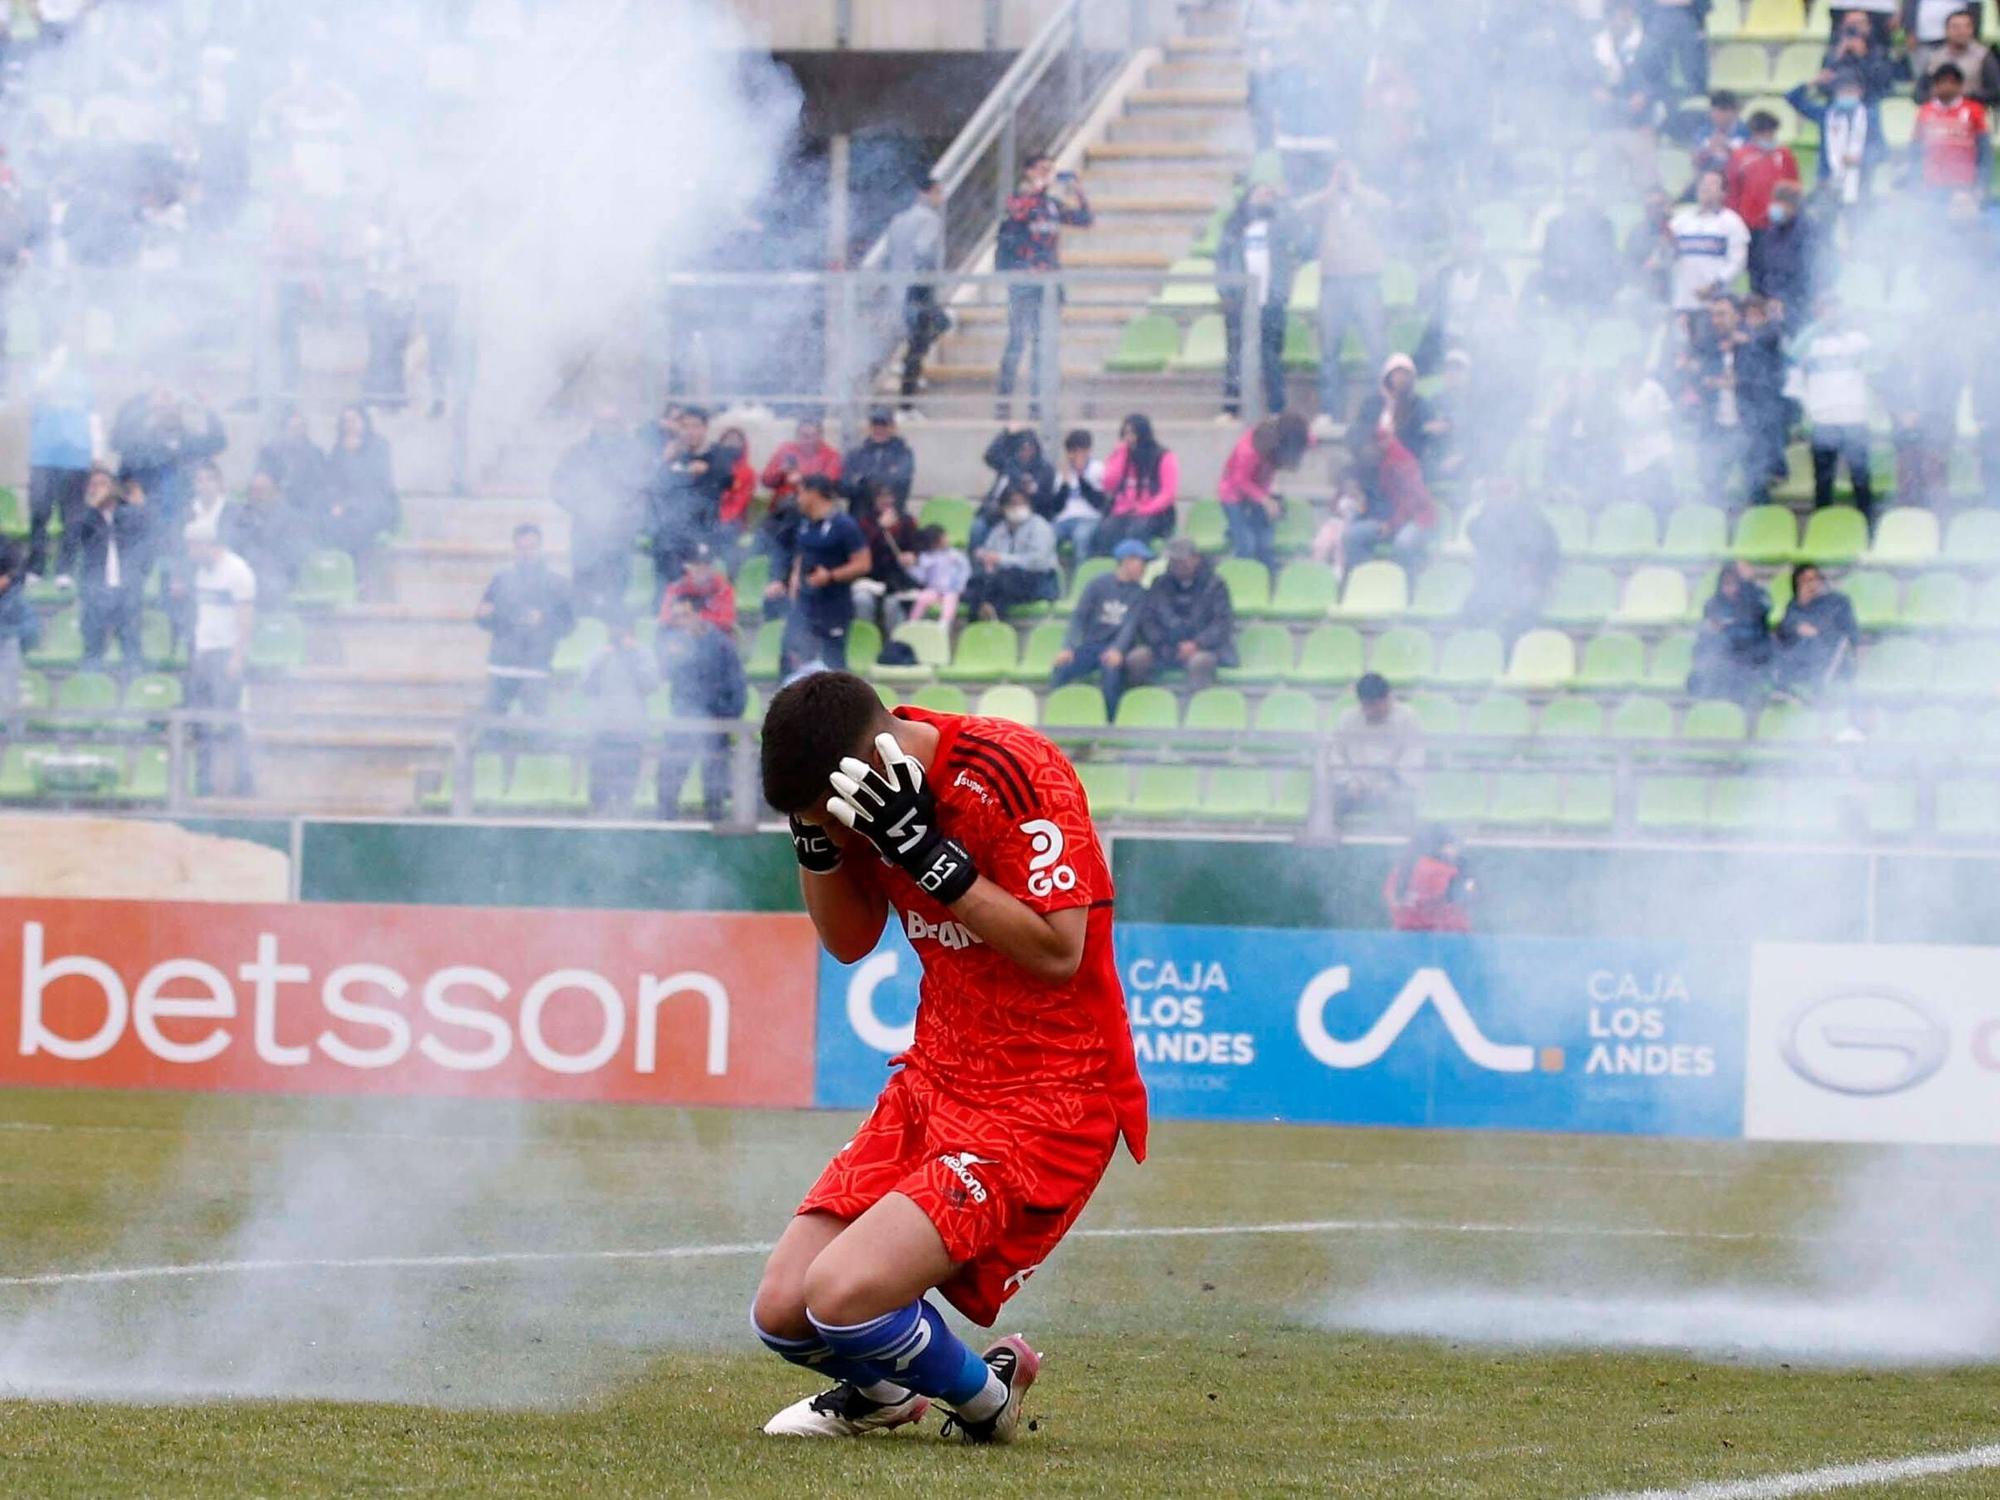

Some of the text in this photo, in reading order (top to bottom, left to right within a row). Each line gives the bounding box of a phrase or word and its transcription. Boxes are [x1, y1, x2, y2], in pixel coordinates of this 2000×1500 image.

[1028, 864, 1076, 897] GO
[1129, 959, 1229, 992] CAJA
[1587, 970, 1690, 1003] CAJA
[19, 921, 730, 1075] betsson
[1131, 995, 1204, 1028] LOS
[1589, 1007, 1666, 1039] LOS
[1134, 1031, 1255, 1065] ANDES
[1585, 1042, 1716, 1076] ANDES
